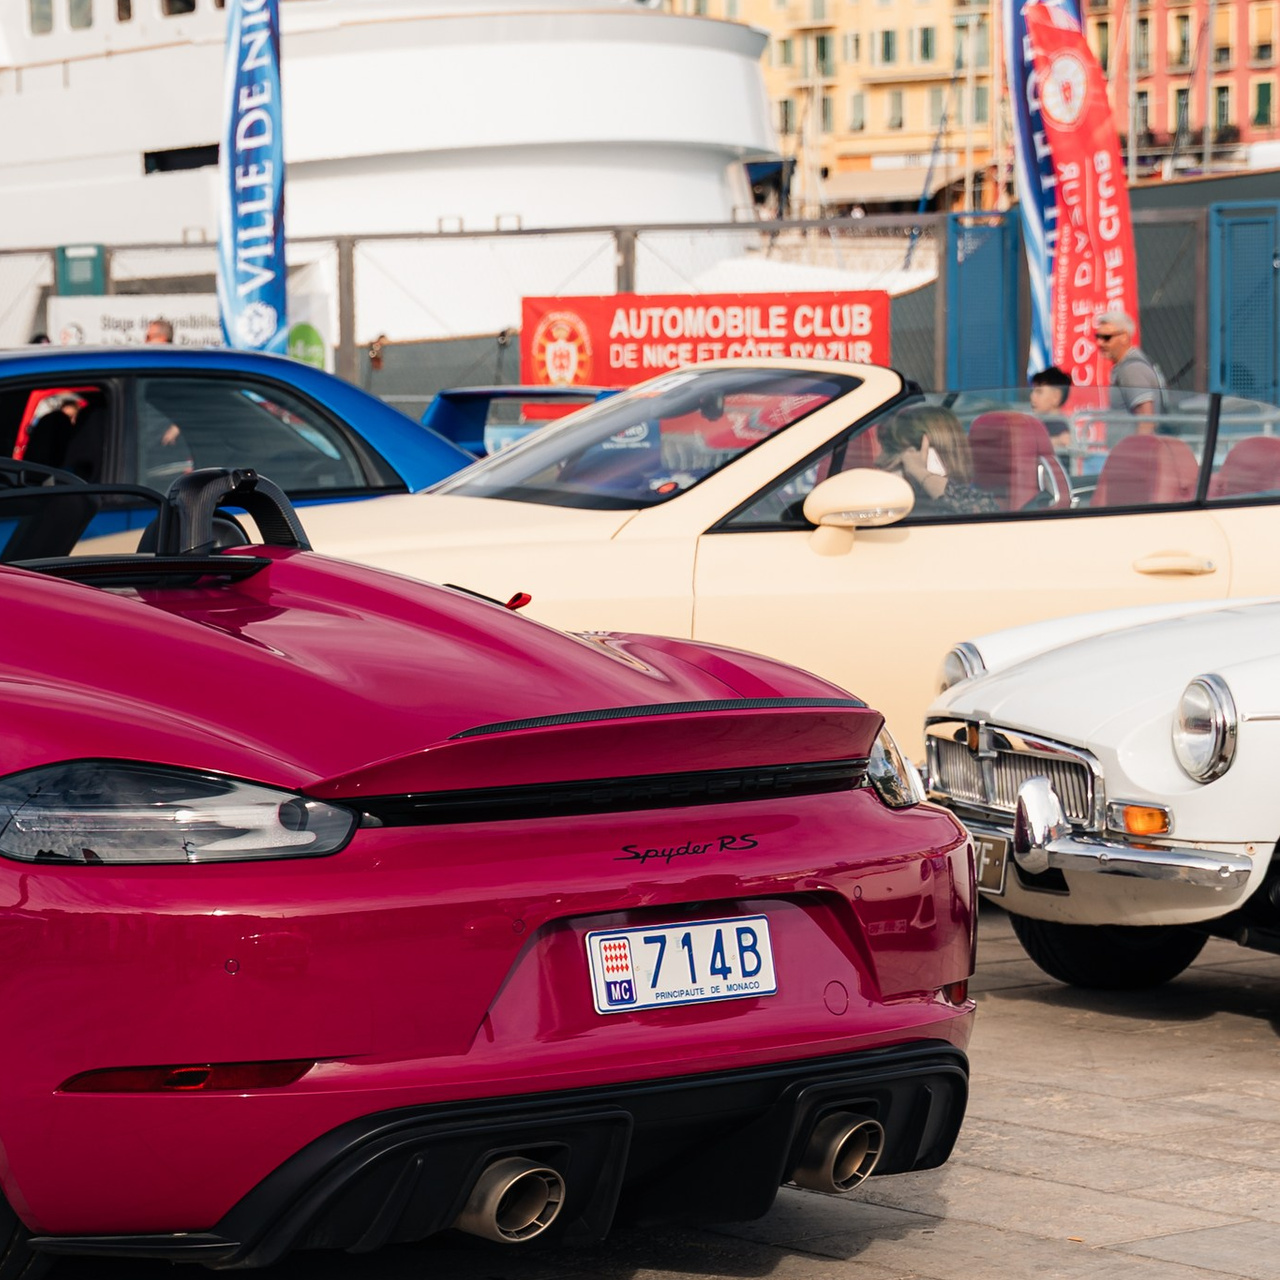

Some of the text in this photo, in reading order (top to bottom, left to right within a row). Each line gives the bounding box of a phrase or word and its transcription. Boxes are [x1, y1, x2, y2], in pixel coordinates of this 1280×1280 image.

[234, 78, 274, 152] DE
[236, 160, 276, 297] VILLE
[609, 303, 872, 340] AUTOMOBILE CLUB
[609, 343, 639, 369] DE
[642, 342, 694, 369] NICE
[613, 834, 759, 865] Spyder RS
[643, 926, 763, 989] 714B
[610, 982, 630, 1001] MC
[655, 980, 760, 1000] PRINCIPAUTE DE MONACO
